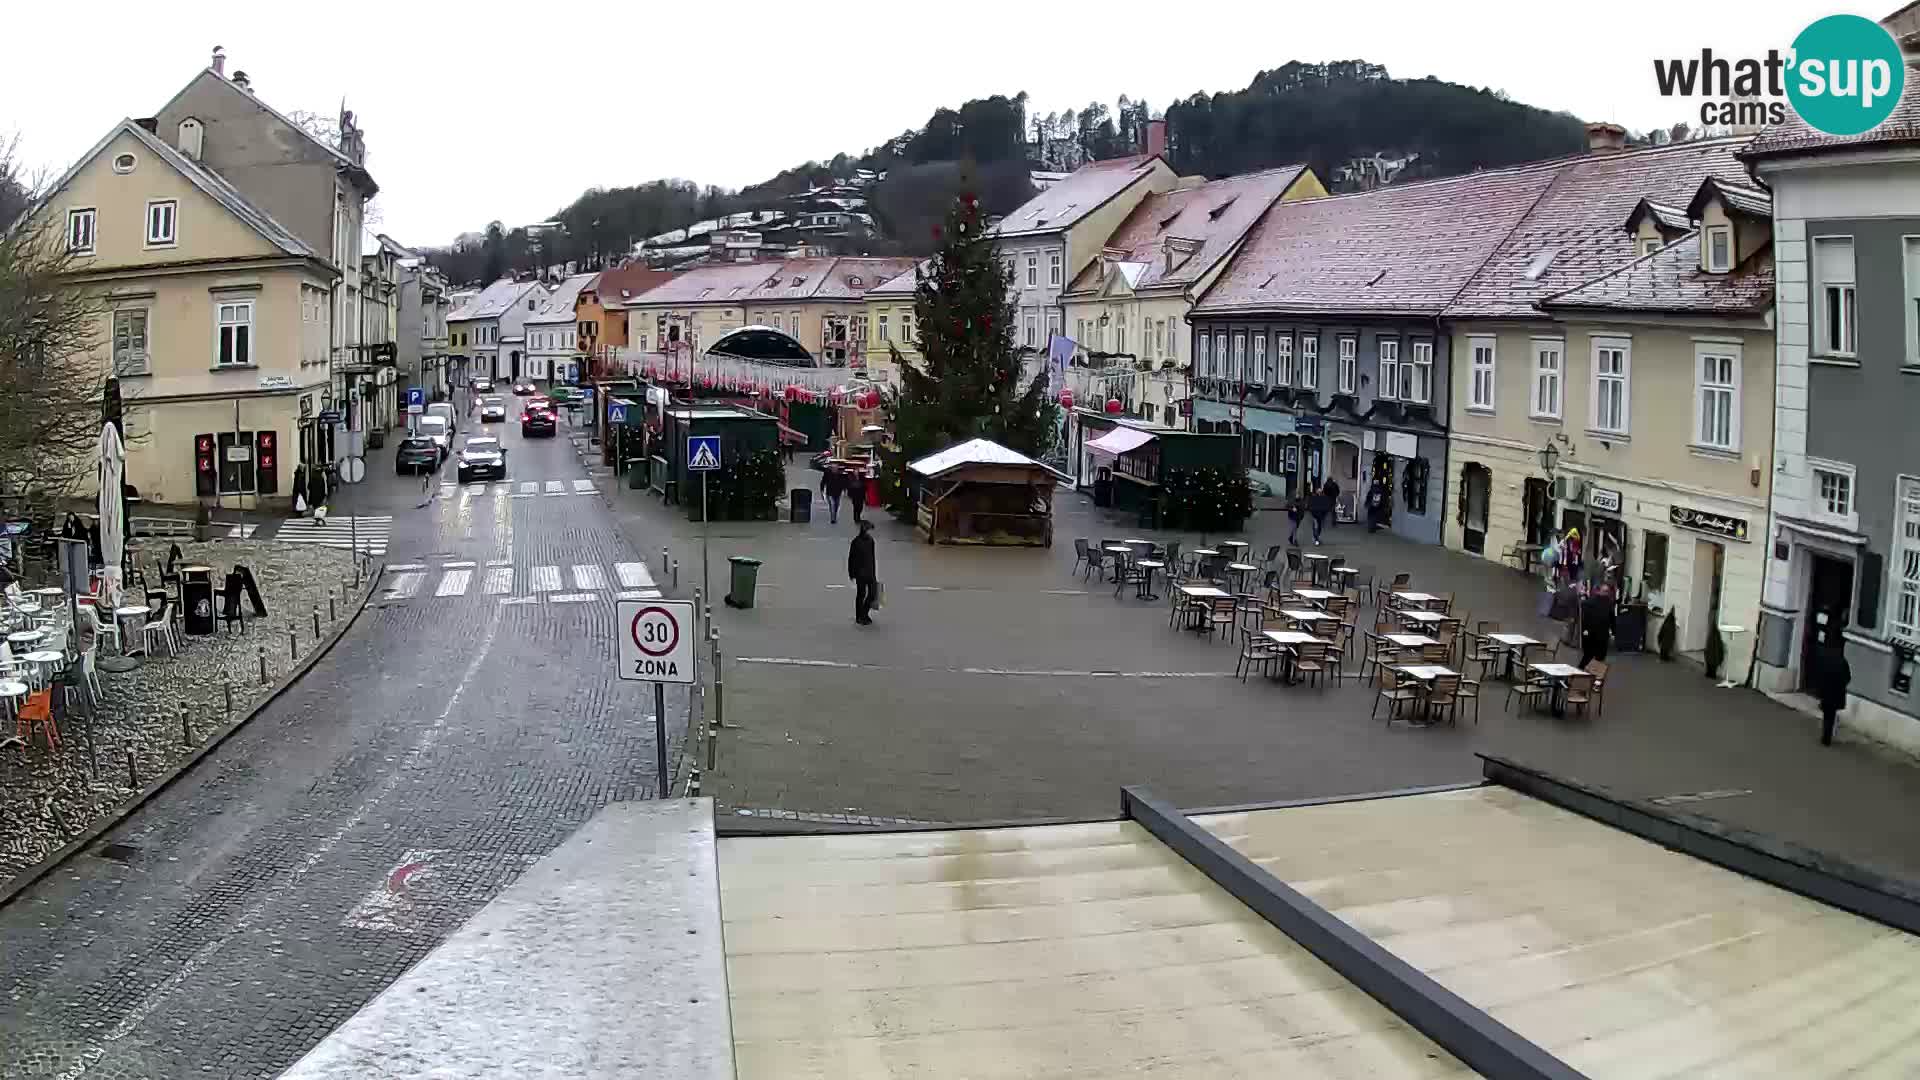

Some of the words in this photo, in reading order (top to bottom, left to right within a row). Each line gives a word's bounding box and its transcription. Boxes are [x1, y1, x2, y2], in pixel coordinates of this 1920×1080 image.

[411, 391, 420, 402] P
[644, 622, 668, 643] 30
[634, 659, 679, 677] ZONA
